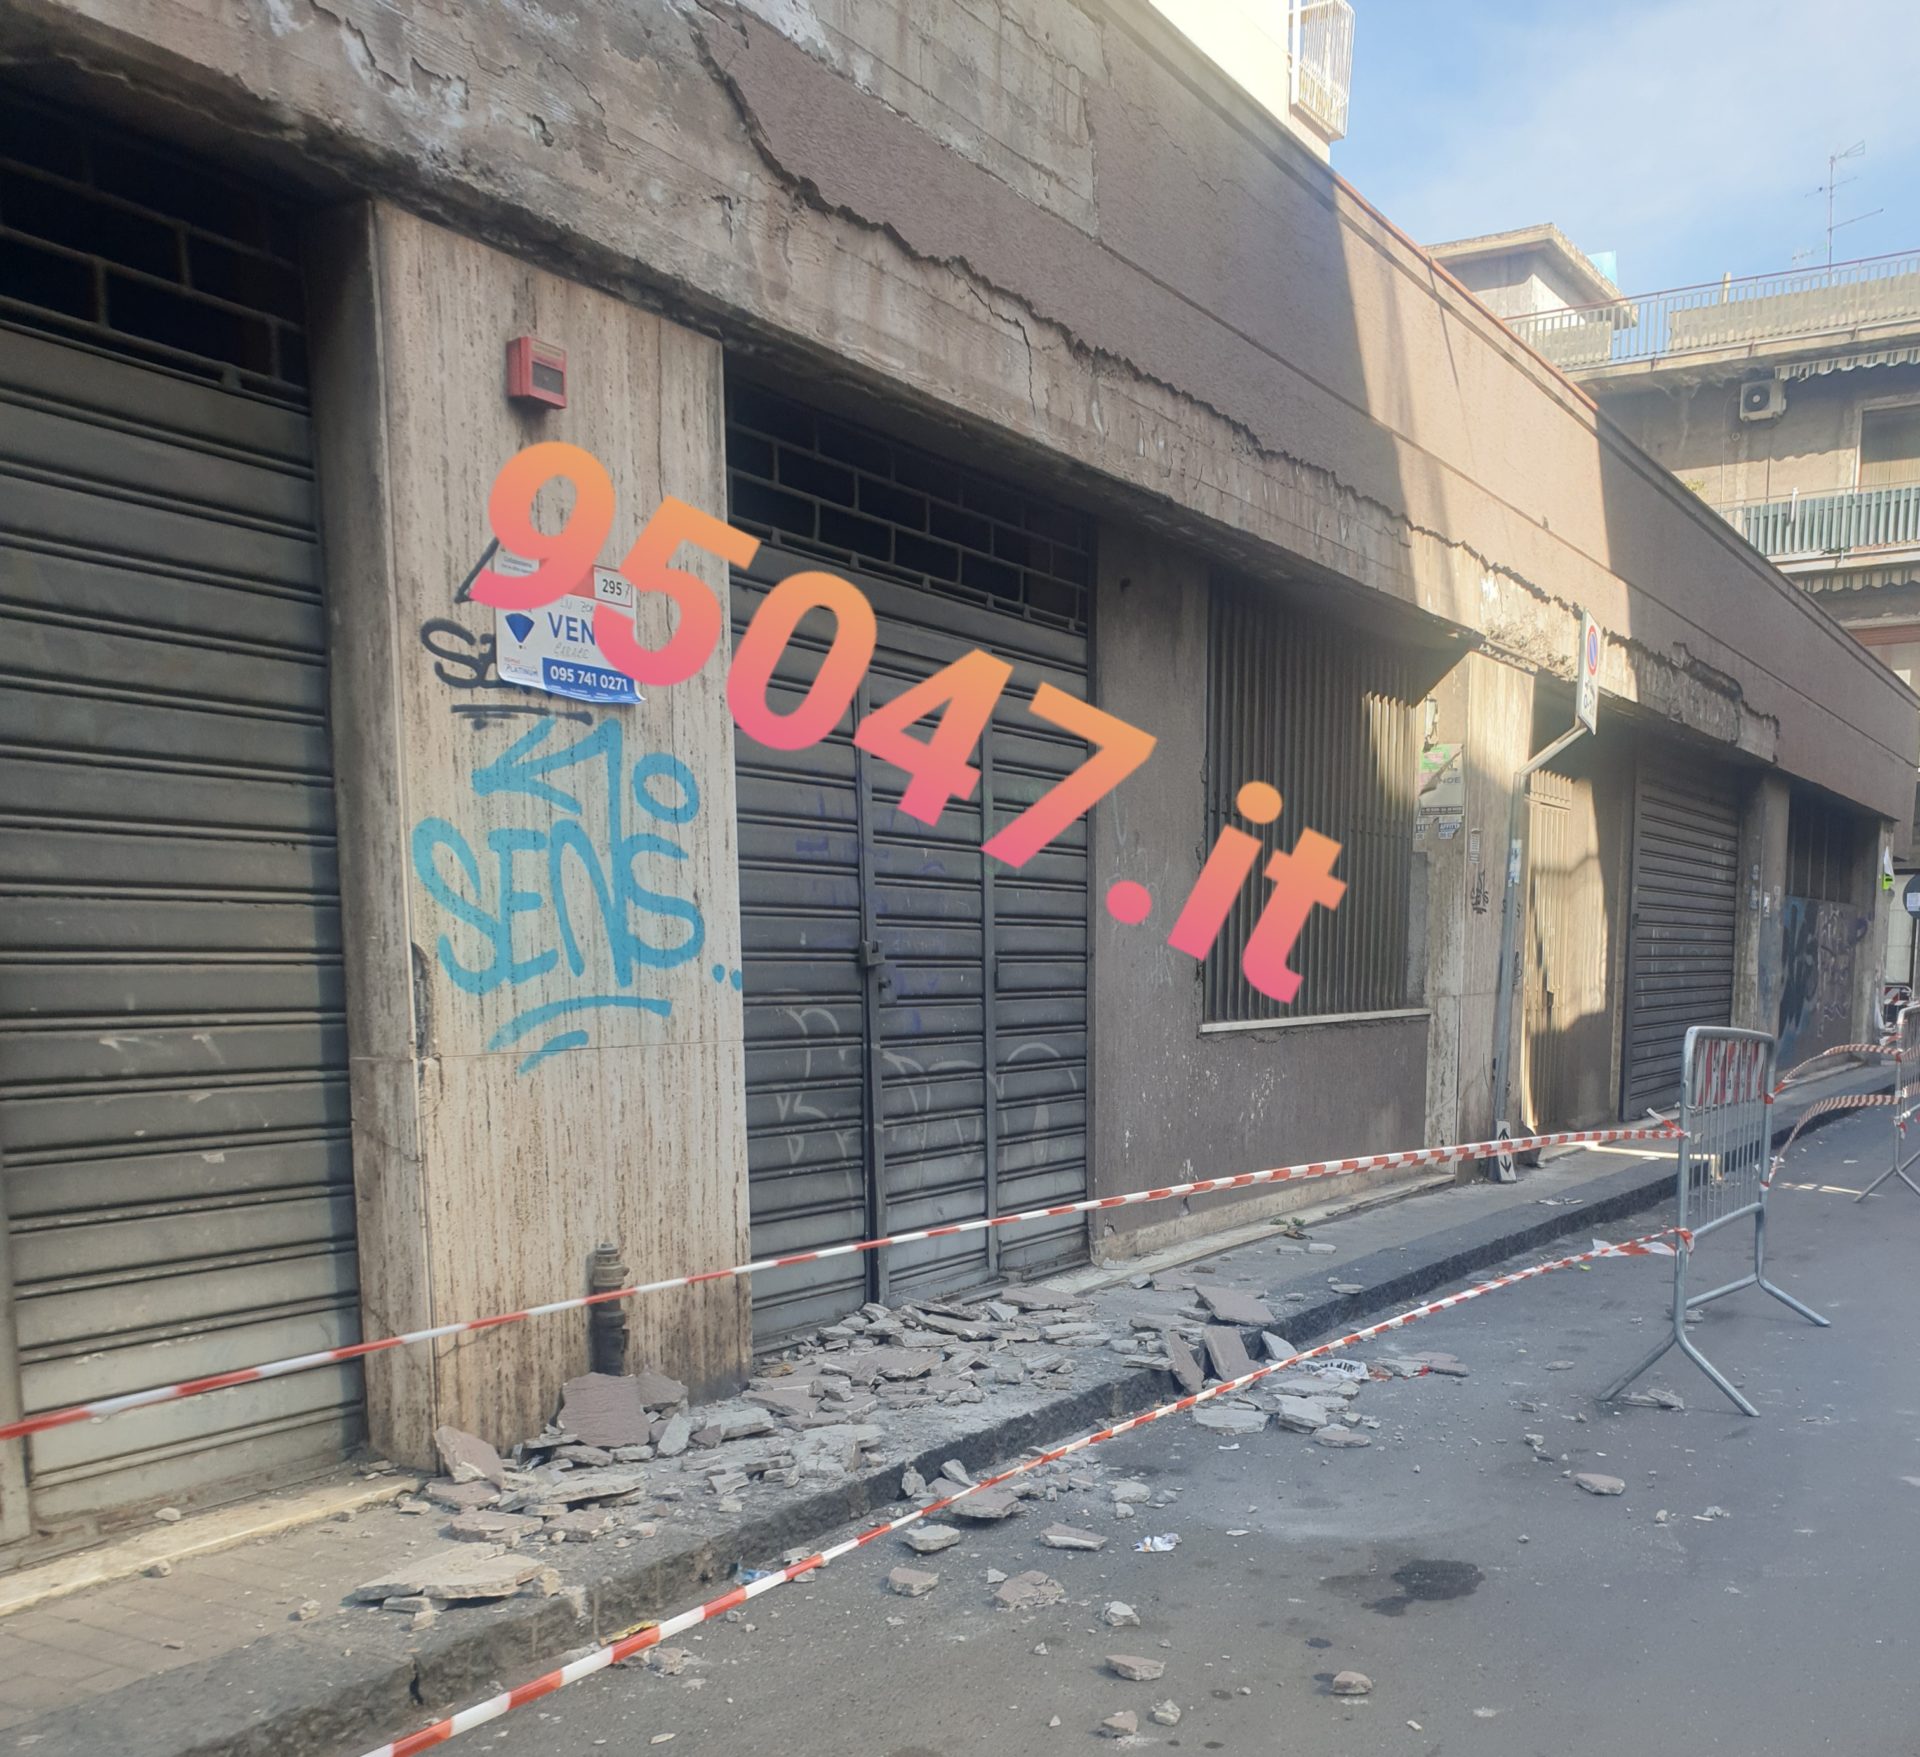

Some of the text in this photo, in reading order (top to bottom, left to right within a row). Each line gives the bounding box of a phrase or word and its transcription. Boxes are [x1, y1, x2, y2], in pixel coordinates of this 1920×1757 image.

[602, 578, 622, 597] 295
[547, 612, 596, 646] VEN
[550, 665, 628, 692] 095 741 0271
